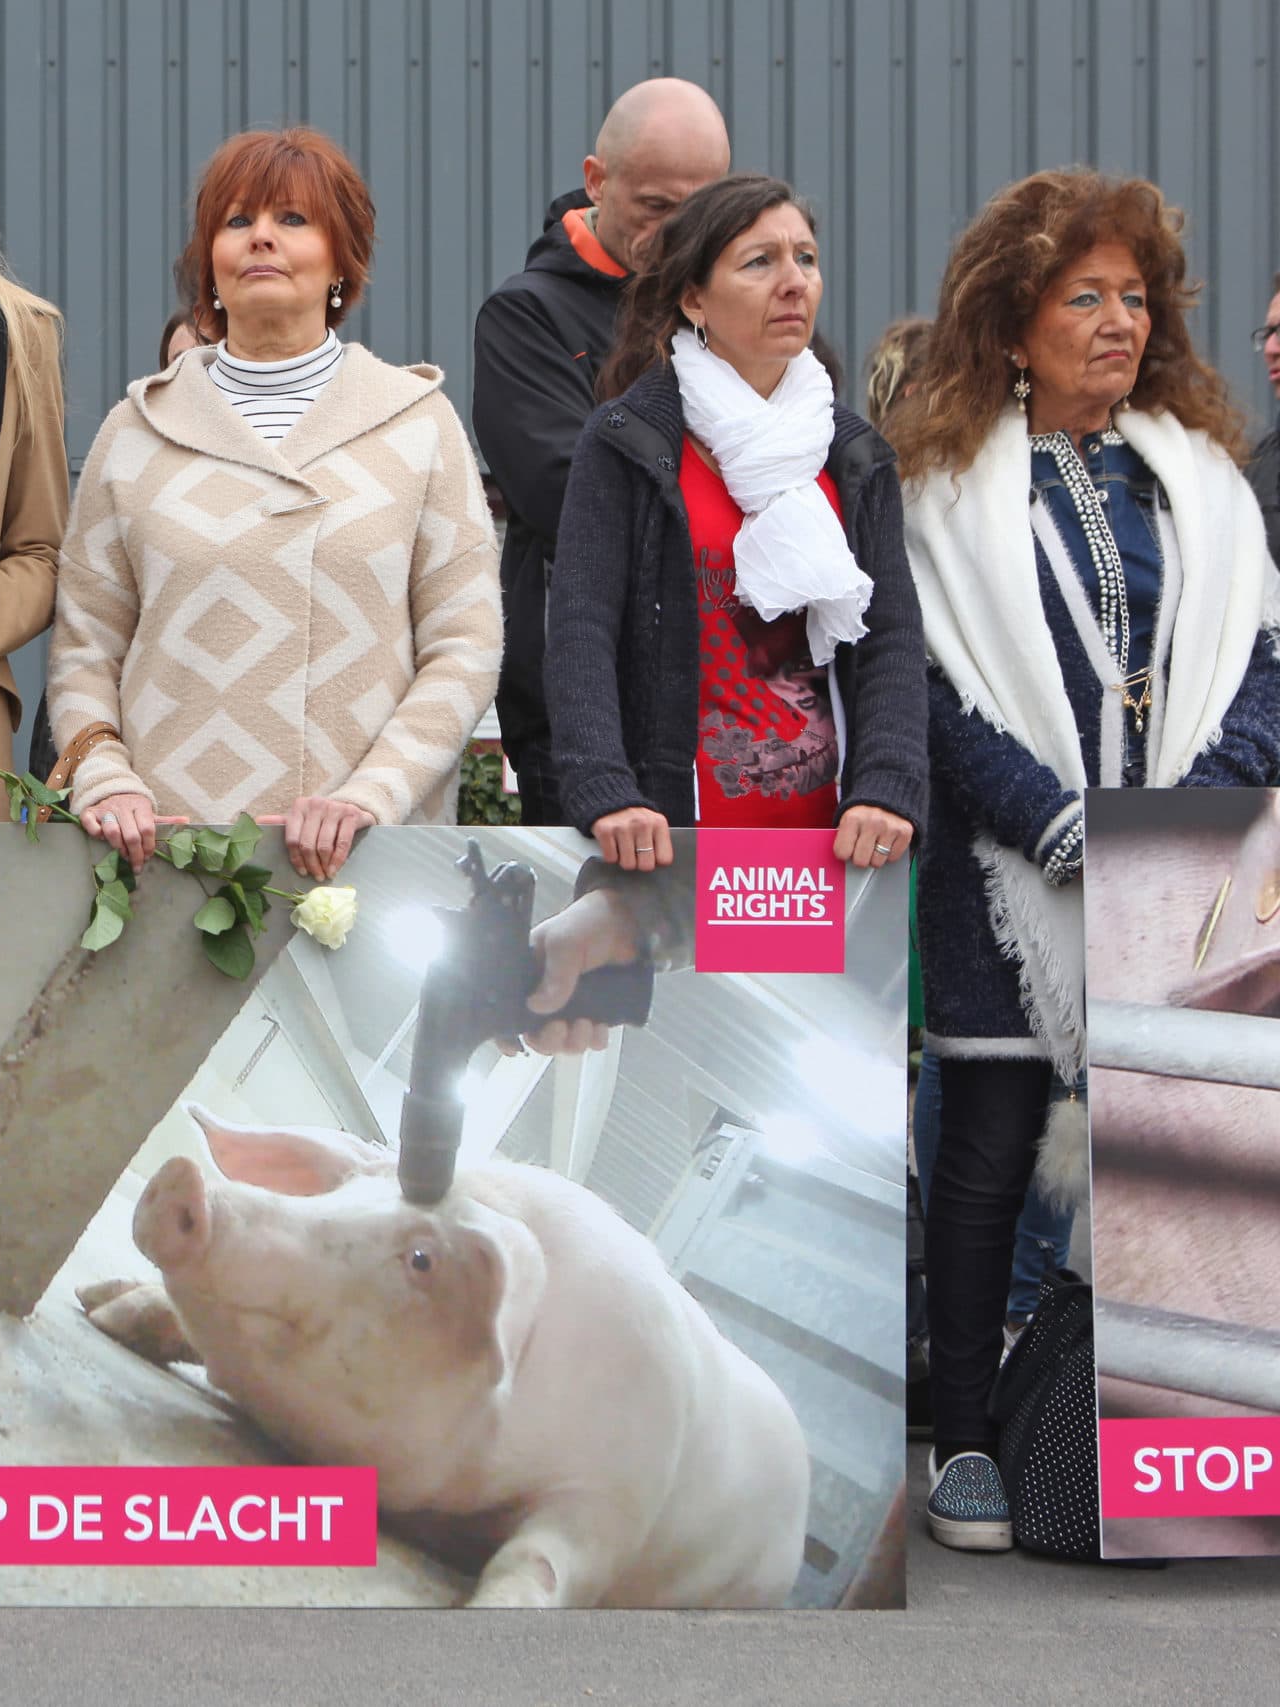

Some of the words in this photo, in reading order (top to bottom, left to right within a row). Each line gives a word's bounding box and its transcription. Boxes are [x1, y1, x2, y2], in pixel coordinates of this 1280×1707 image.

[708, 867, 834, 892] ANIMAL
[715, 893, 826, 918] RIGHTS
[1133, 1446, 1273, 1493] STOP
[28, 1494, 103, 1541] DE
[123, 1494, 344, 1542] SLACHT
